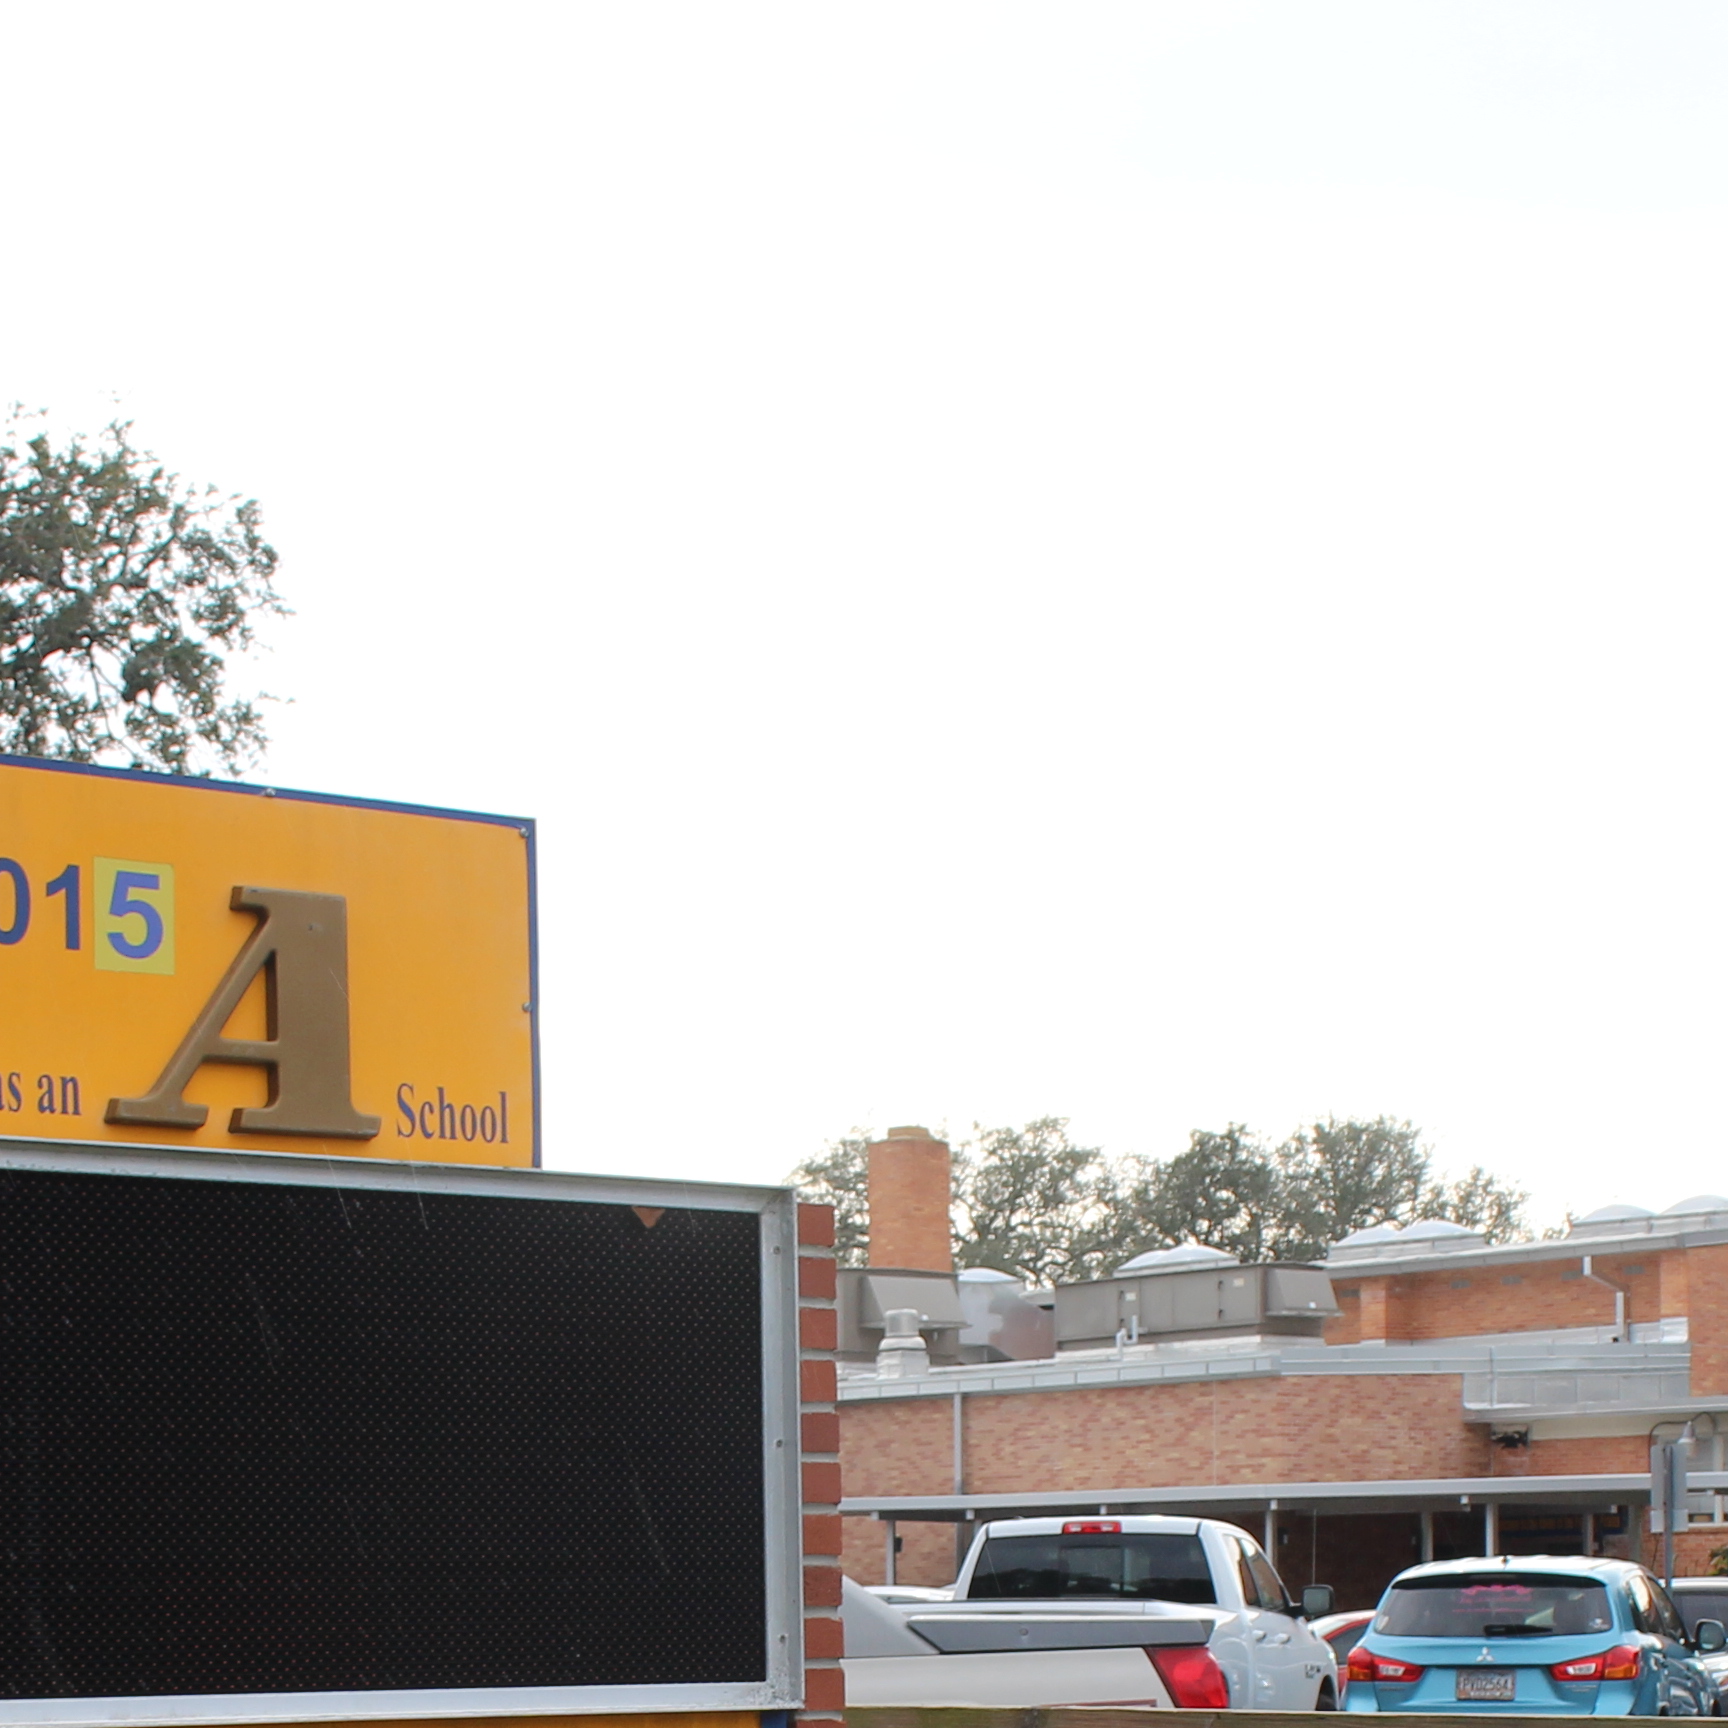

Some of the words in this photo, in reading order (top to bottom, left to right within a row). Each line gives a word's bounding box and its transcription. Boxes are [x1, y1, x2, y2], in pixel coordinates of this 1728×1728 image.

[37, 1072, 83, 1117] an
[104, 885, 382, 1140] A
[396, 1082, 510, 1144] School
